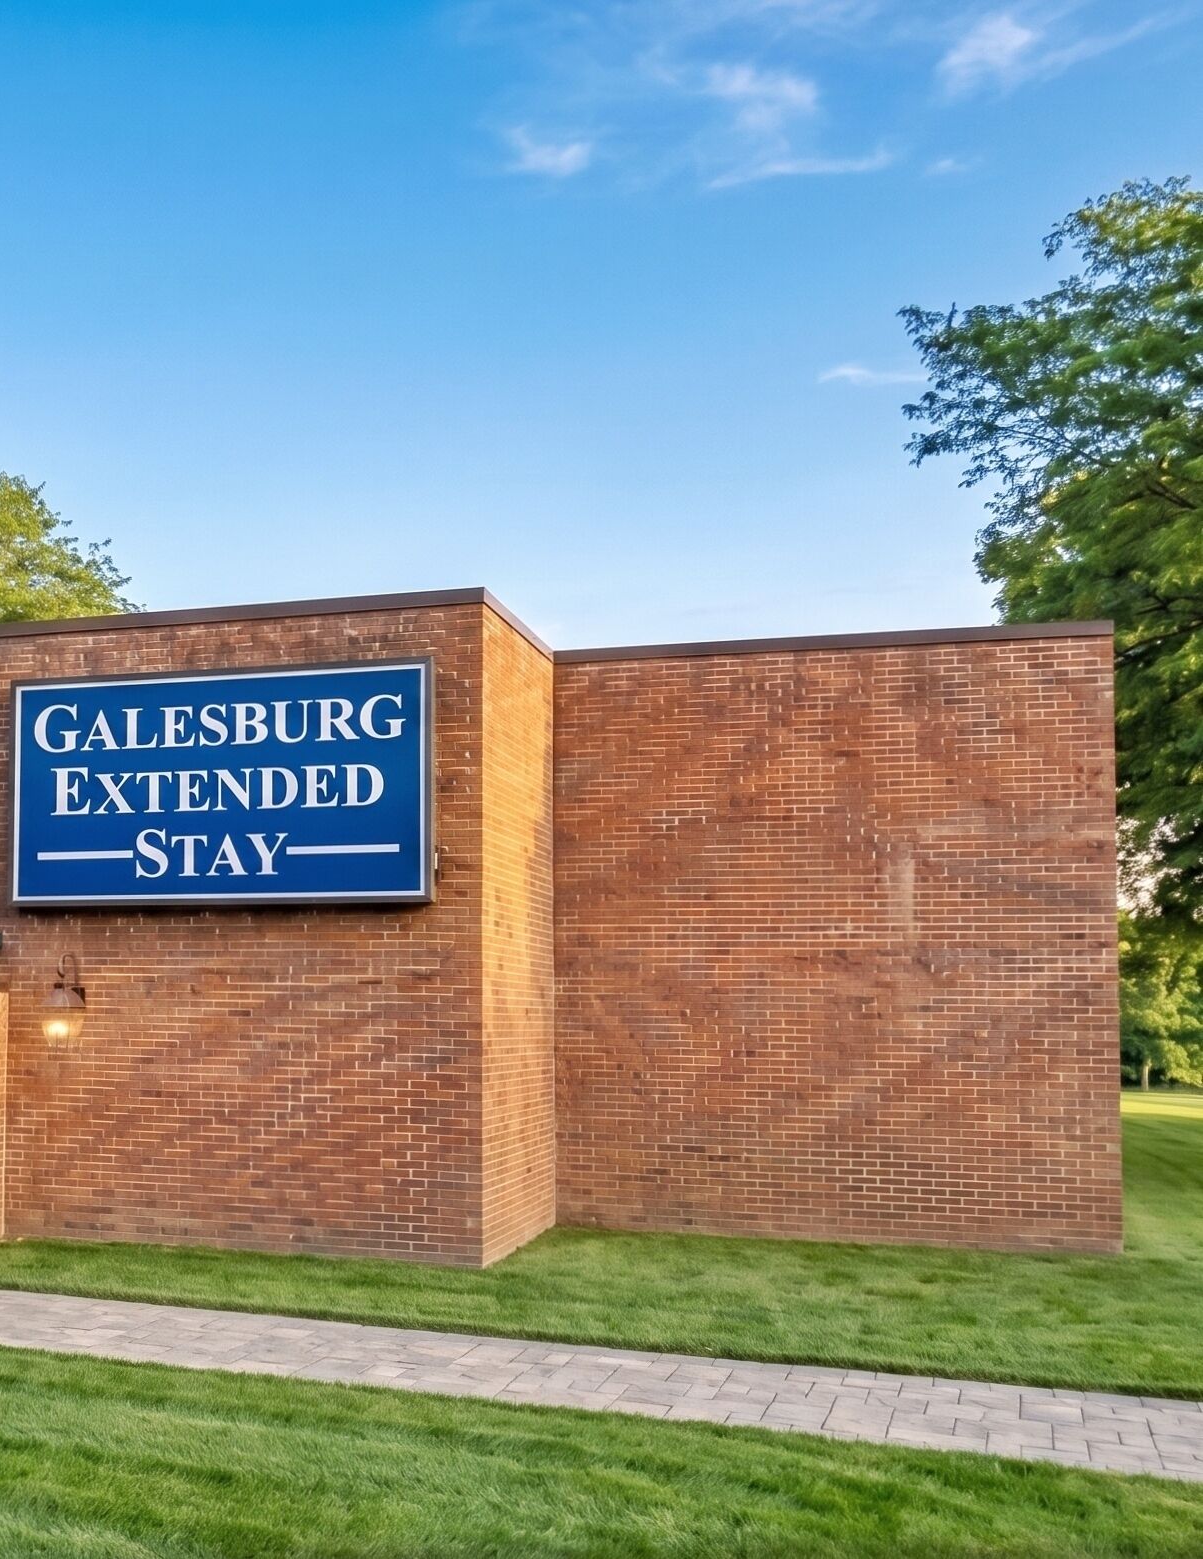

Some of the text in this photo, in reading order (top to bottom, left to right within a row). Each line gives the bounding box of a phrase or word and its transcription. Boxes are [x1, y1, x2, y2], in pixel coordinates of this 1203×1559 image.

[33, 694, 406, 754] GALESBURG
[50, 763, 385, 816] EXTENDED
[135, 828, 289, 879] STAY
